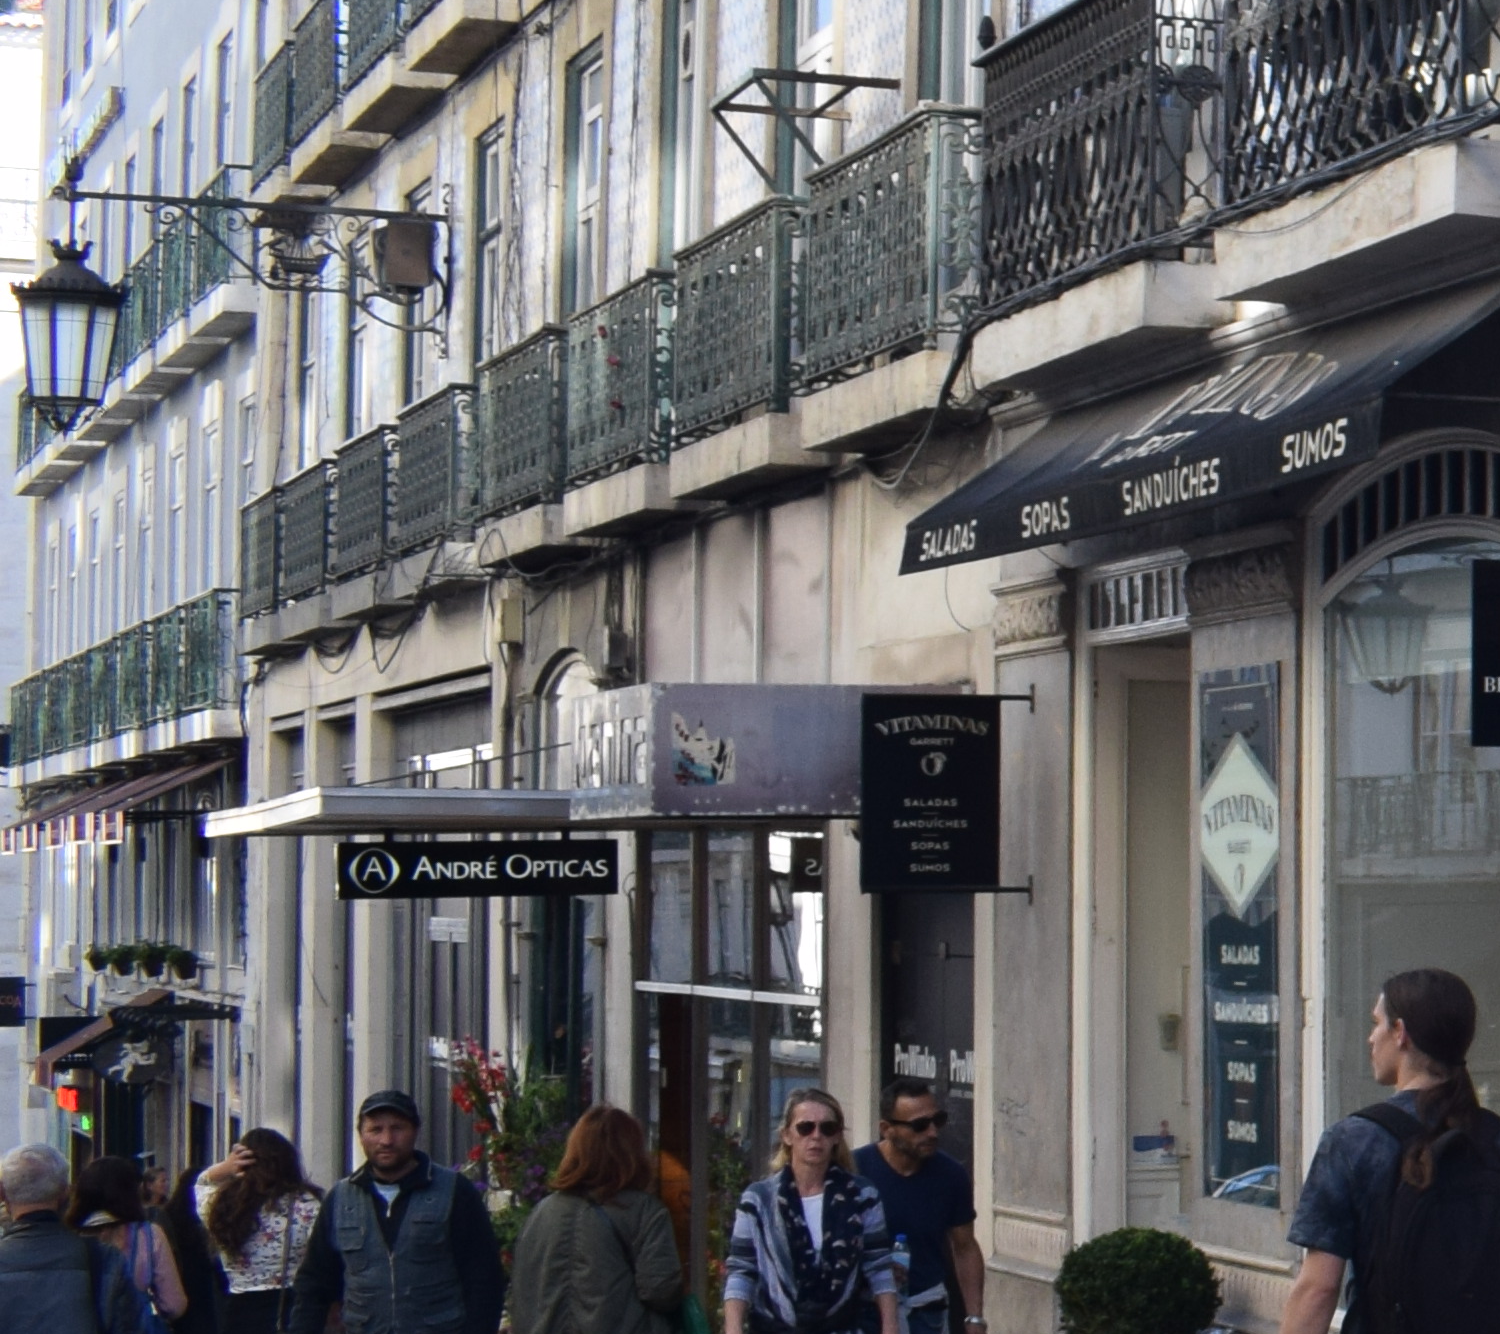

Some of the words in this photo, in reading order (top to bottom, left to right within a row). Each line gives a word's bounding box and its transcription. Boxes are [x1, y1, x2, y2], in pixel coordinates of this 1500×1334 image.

[919, 520, 978, 562] SALADAS
[1021, 497, 1071, 538] SOPAS
[1122, 455, 1220, 517] SANDUÍCHES
[1281, 418, 1349, 474] SUMOS
[874, 714, 990, 736] VITAMINAS
[909, 737, 955, 746] GARRETT
[904, 798, 958, 807] SALADAS
[893, 817, 968, 828] SANDUÍCHES
[1204, 794, 1275, 835] VITAMINAS
[910, 841, 950, 850] SOPAS
[412, 855, 498, 880] ANDRÉ
[505, 853, 609, 879] OPTICAS
[909, 863, 950, 872] SUMOS
[1221, 944, 1260, 965] SALADAS
[1227, 1061, 1256, 1083] SOPAS
[1227, 1120, 1257, 1143] SUMOS
